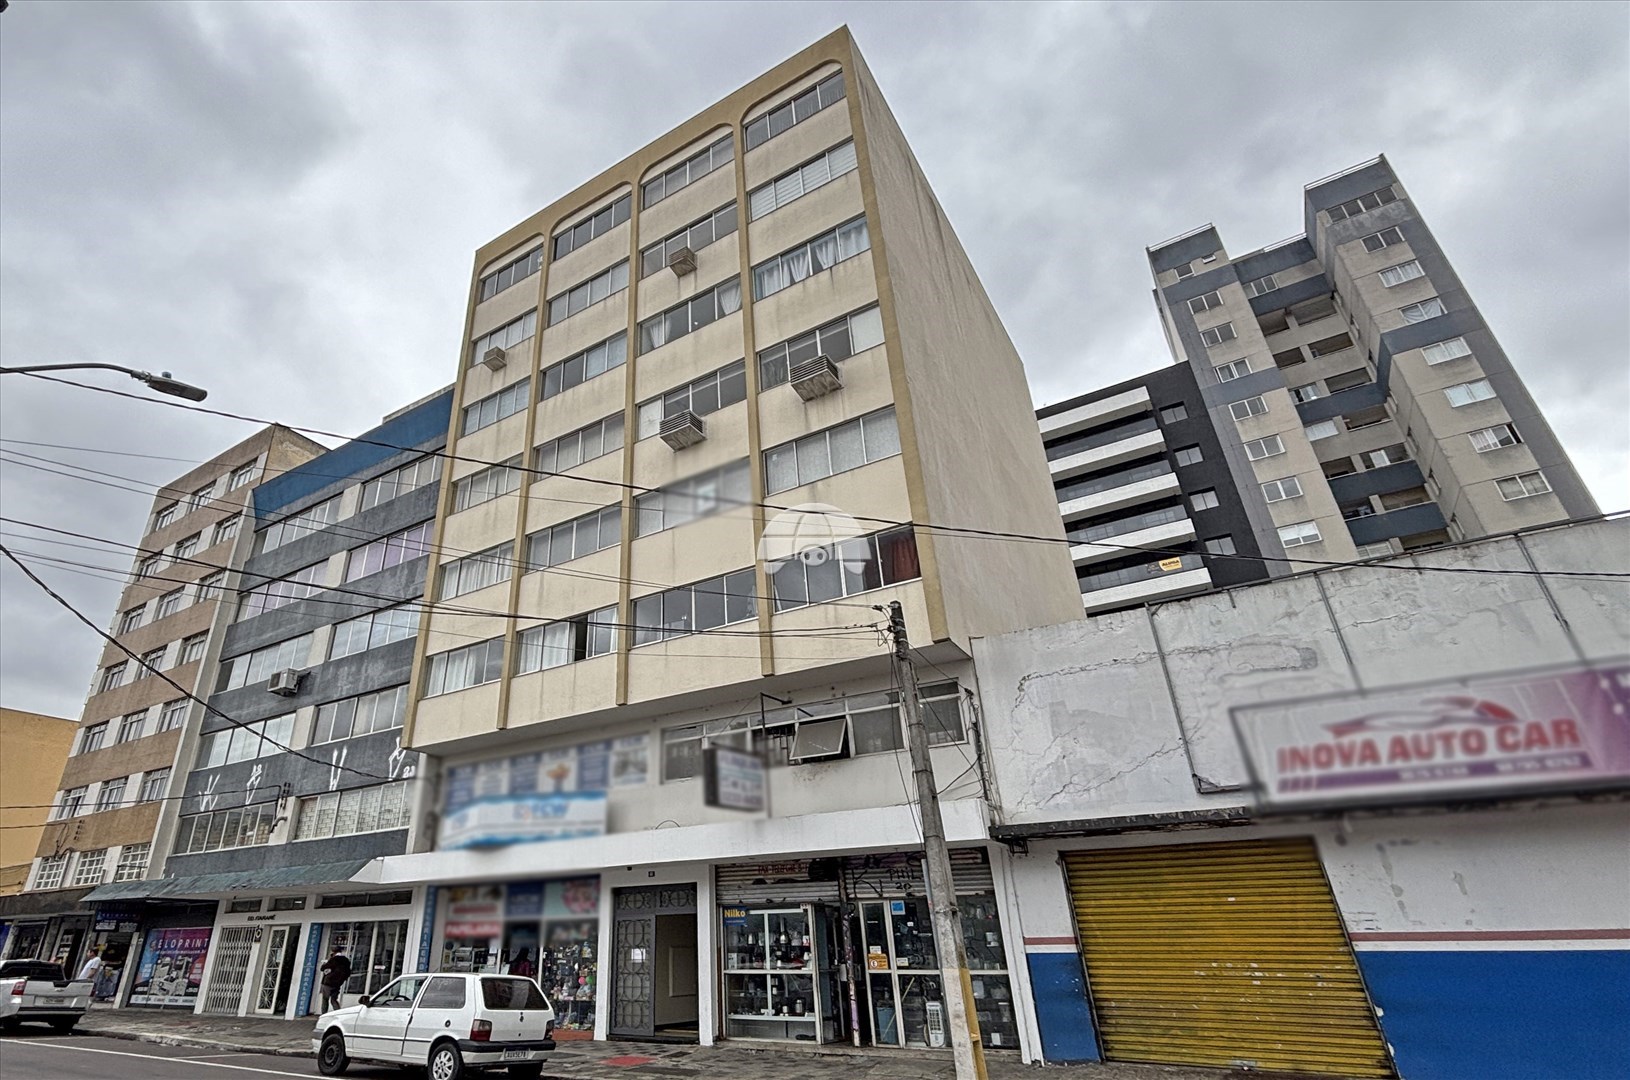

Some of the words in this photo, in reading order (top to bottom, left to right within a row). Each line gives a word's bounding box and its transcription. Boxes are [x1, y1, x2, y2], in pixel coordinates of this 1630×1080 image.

[1278, 739, 1381, 774] INOVA
[1388, 729, 1488, 763] AUTO
[1495, 718, 1581, 751] CAR
[724, 909, 746, 918] Nilko
[306, 925, 319, 966] PAPELARIA
